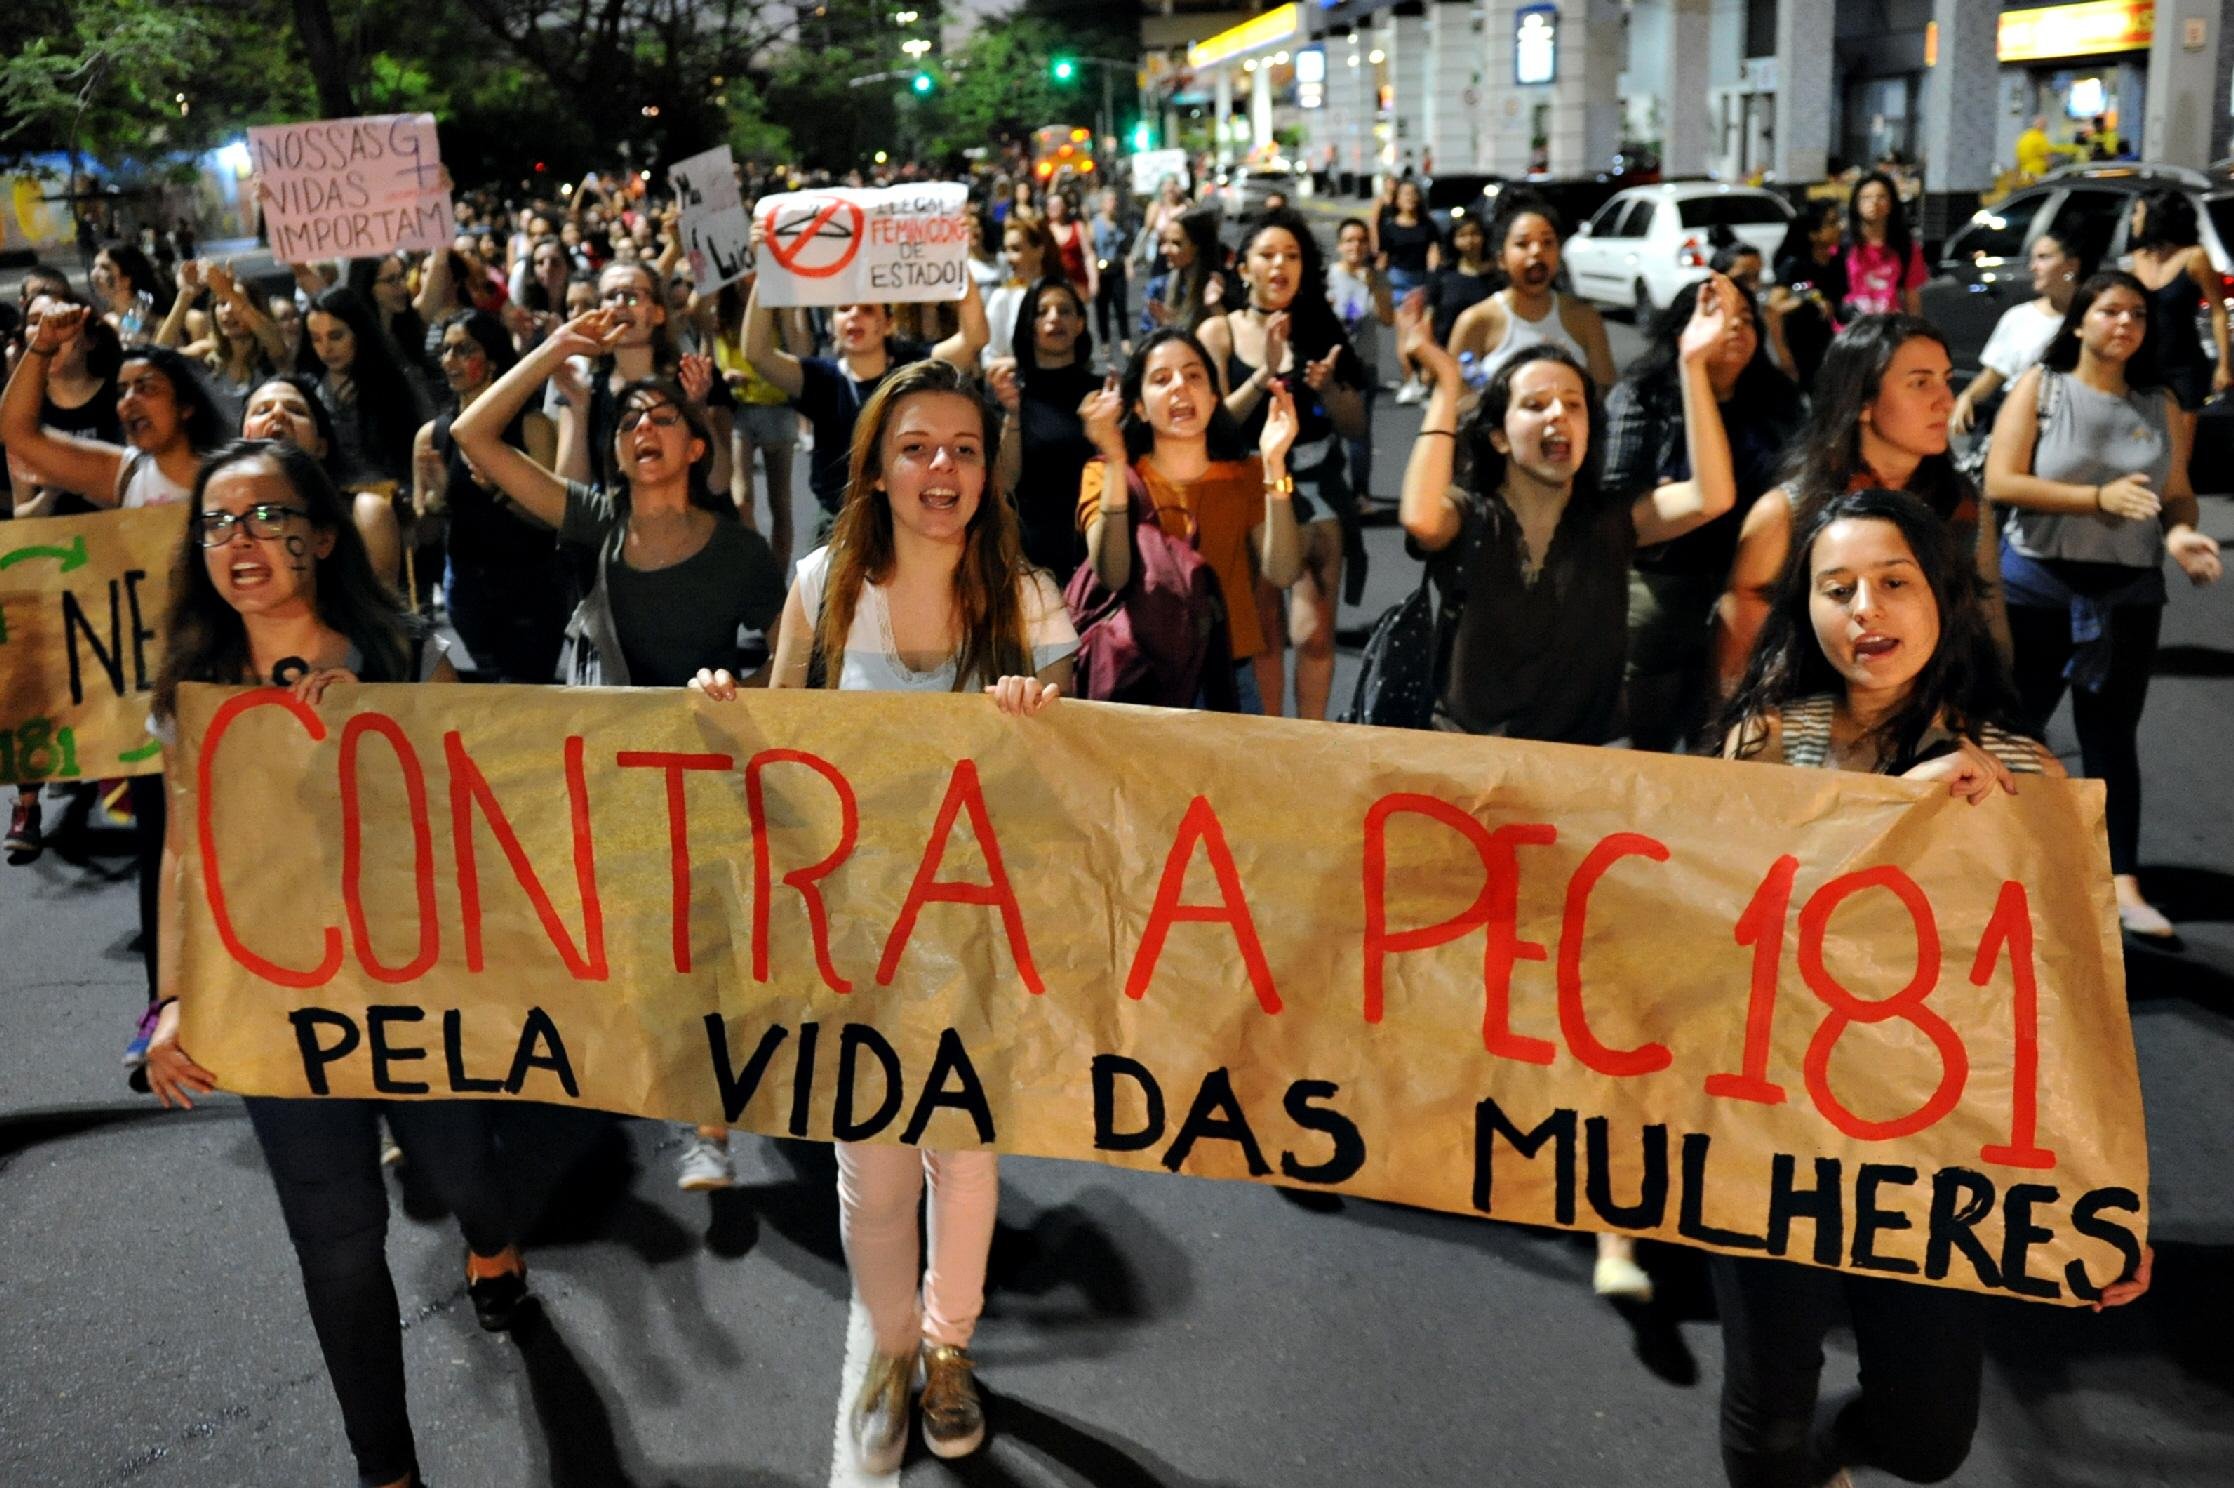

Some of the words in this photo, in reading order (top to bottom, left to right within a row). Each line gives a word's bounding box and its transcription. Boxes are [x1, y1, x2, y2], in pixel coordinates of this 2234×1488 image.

[257, 122, 384, 174] NOSSAS
[264, 169, 369, 215] VIDAS
[276, 200, 446, 259] IMPORTAM
[899, 240, 927, 260] DE
[870, 259, 964, 291] ESTADO!
[197, 686, 1046, 996] CONTRA
[1124, 794, 1284, 1016] A
[1362, 792, 1674, 1077] PEC
[1703, 853, 2059, 1169] 181
[288, 1004, 581, 1099] PELA
[703, 1012, 997, 1146] VIDA
[1090, 1053, 1367, 1185] DAS
[1472, 1095, 2143, 1302] MULHERES
